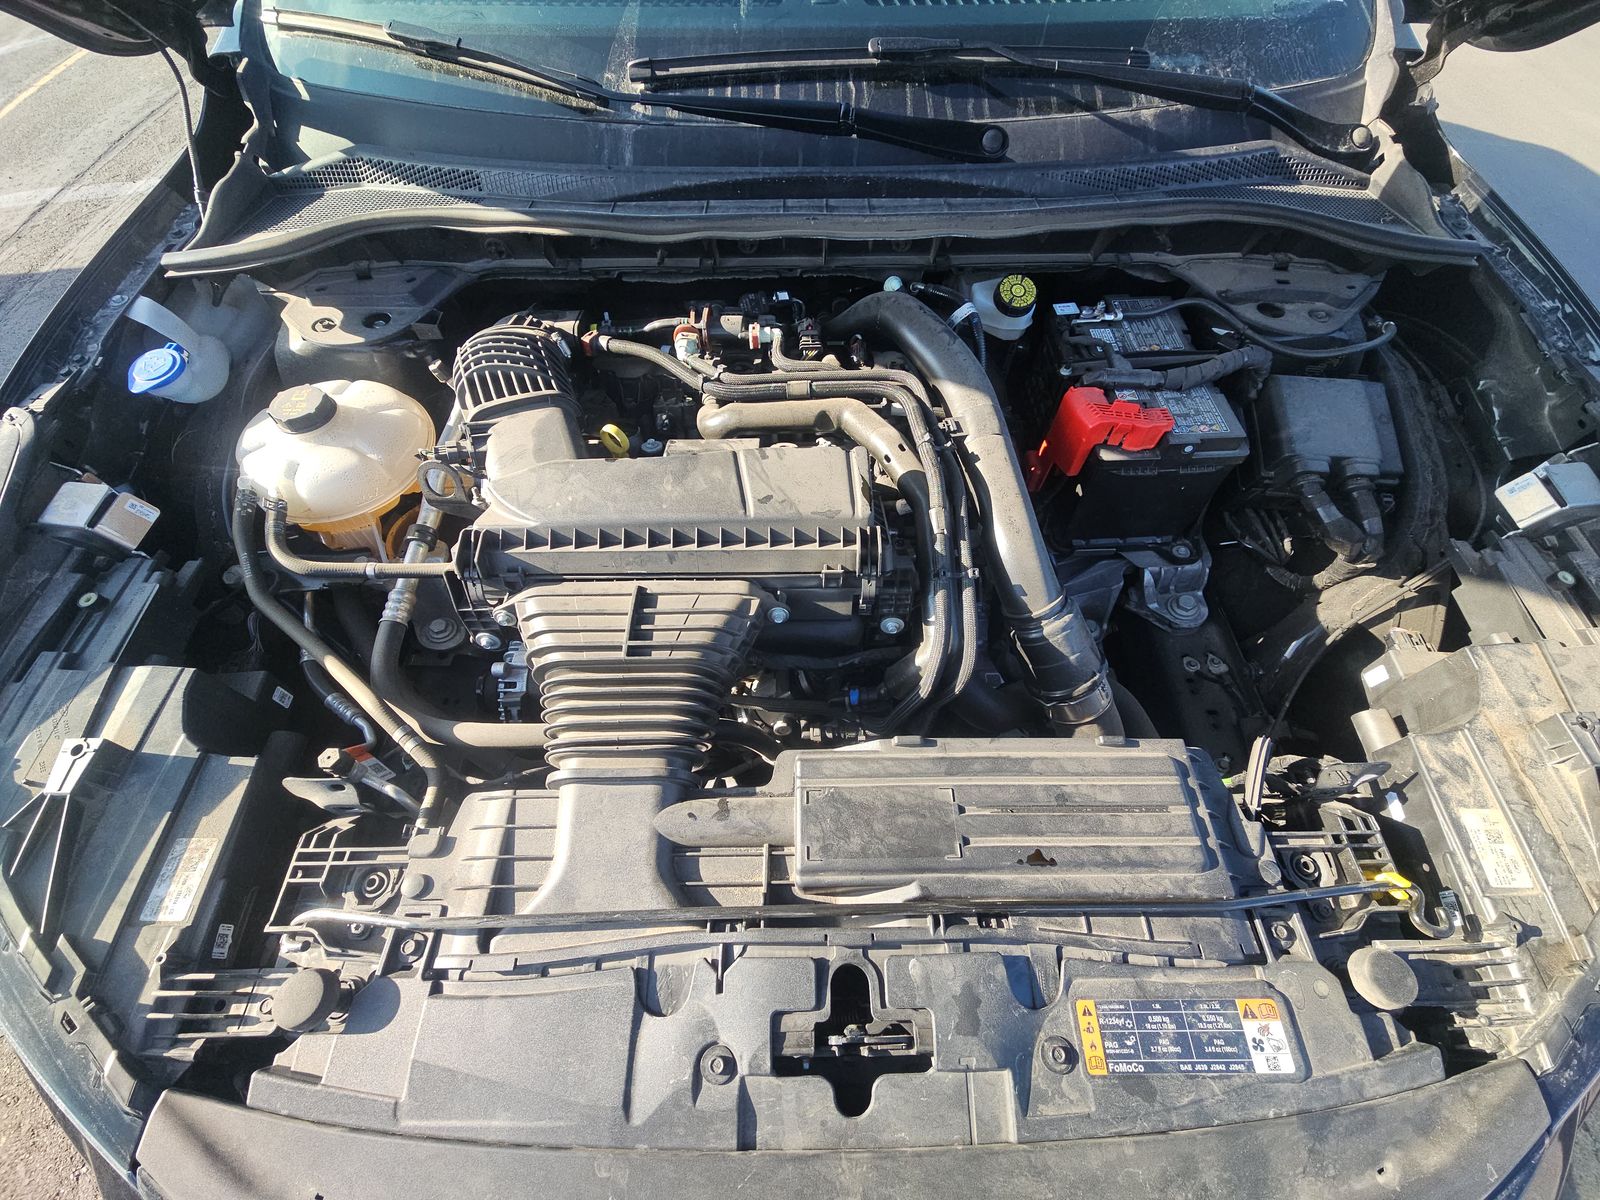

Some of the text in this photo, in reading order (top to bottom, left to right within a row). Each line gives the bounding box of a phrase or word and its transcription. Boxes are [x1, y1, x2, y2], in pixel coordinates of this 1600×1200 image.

[1099, 1017, 1125, 1026] R-1234yf
[1162, 1015, 1170, 1024] kg
[1215, 1014, 1224, 1023] kg
[1104, 1041, 1119, 1049] PAG
[1213, 1038, 1225, 1046] PAG
[1109, 1063, 1144, 1073] FoMoCo
[1179, 1063, 1193, 1071] SAE
